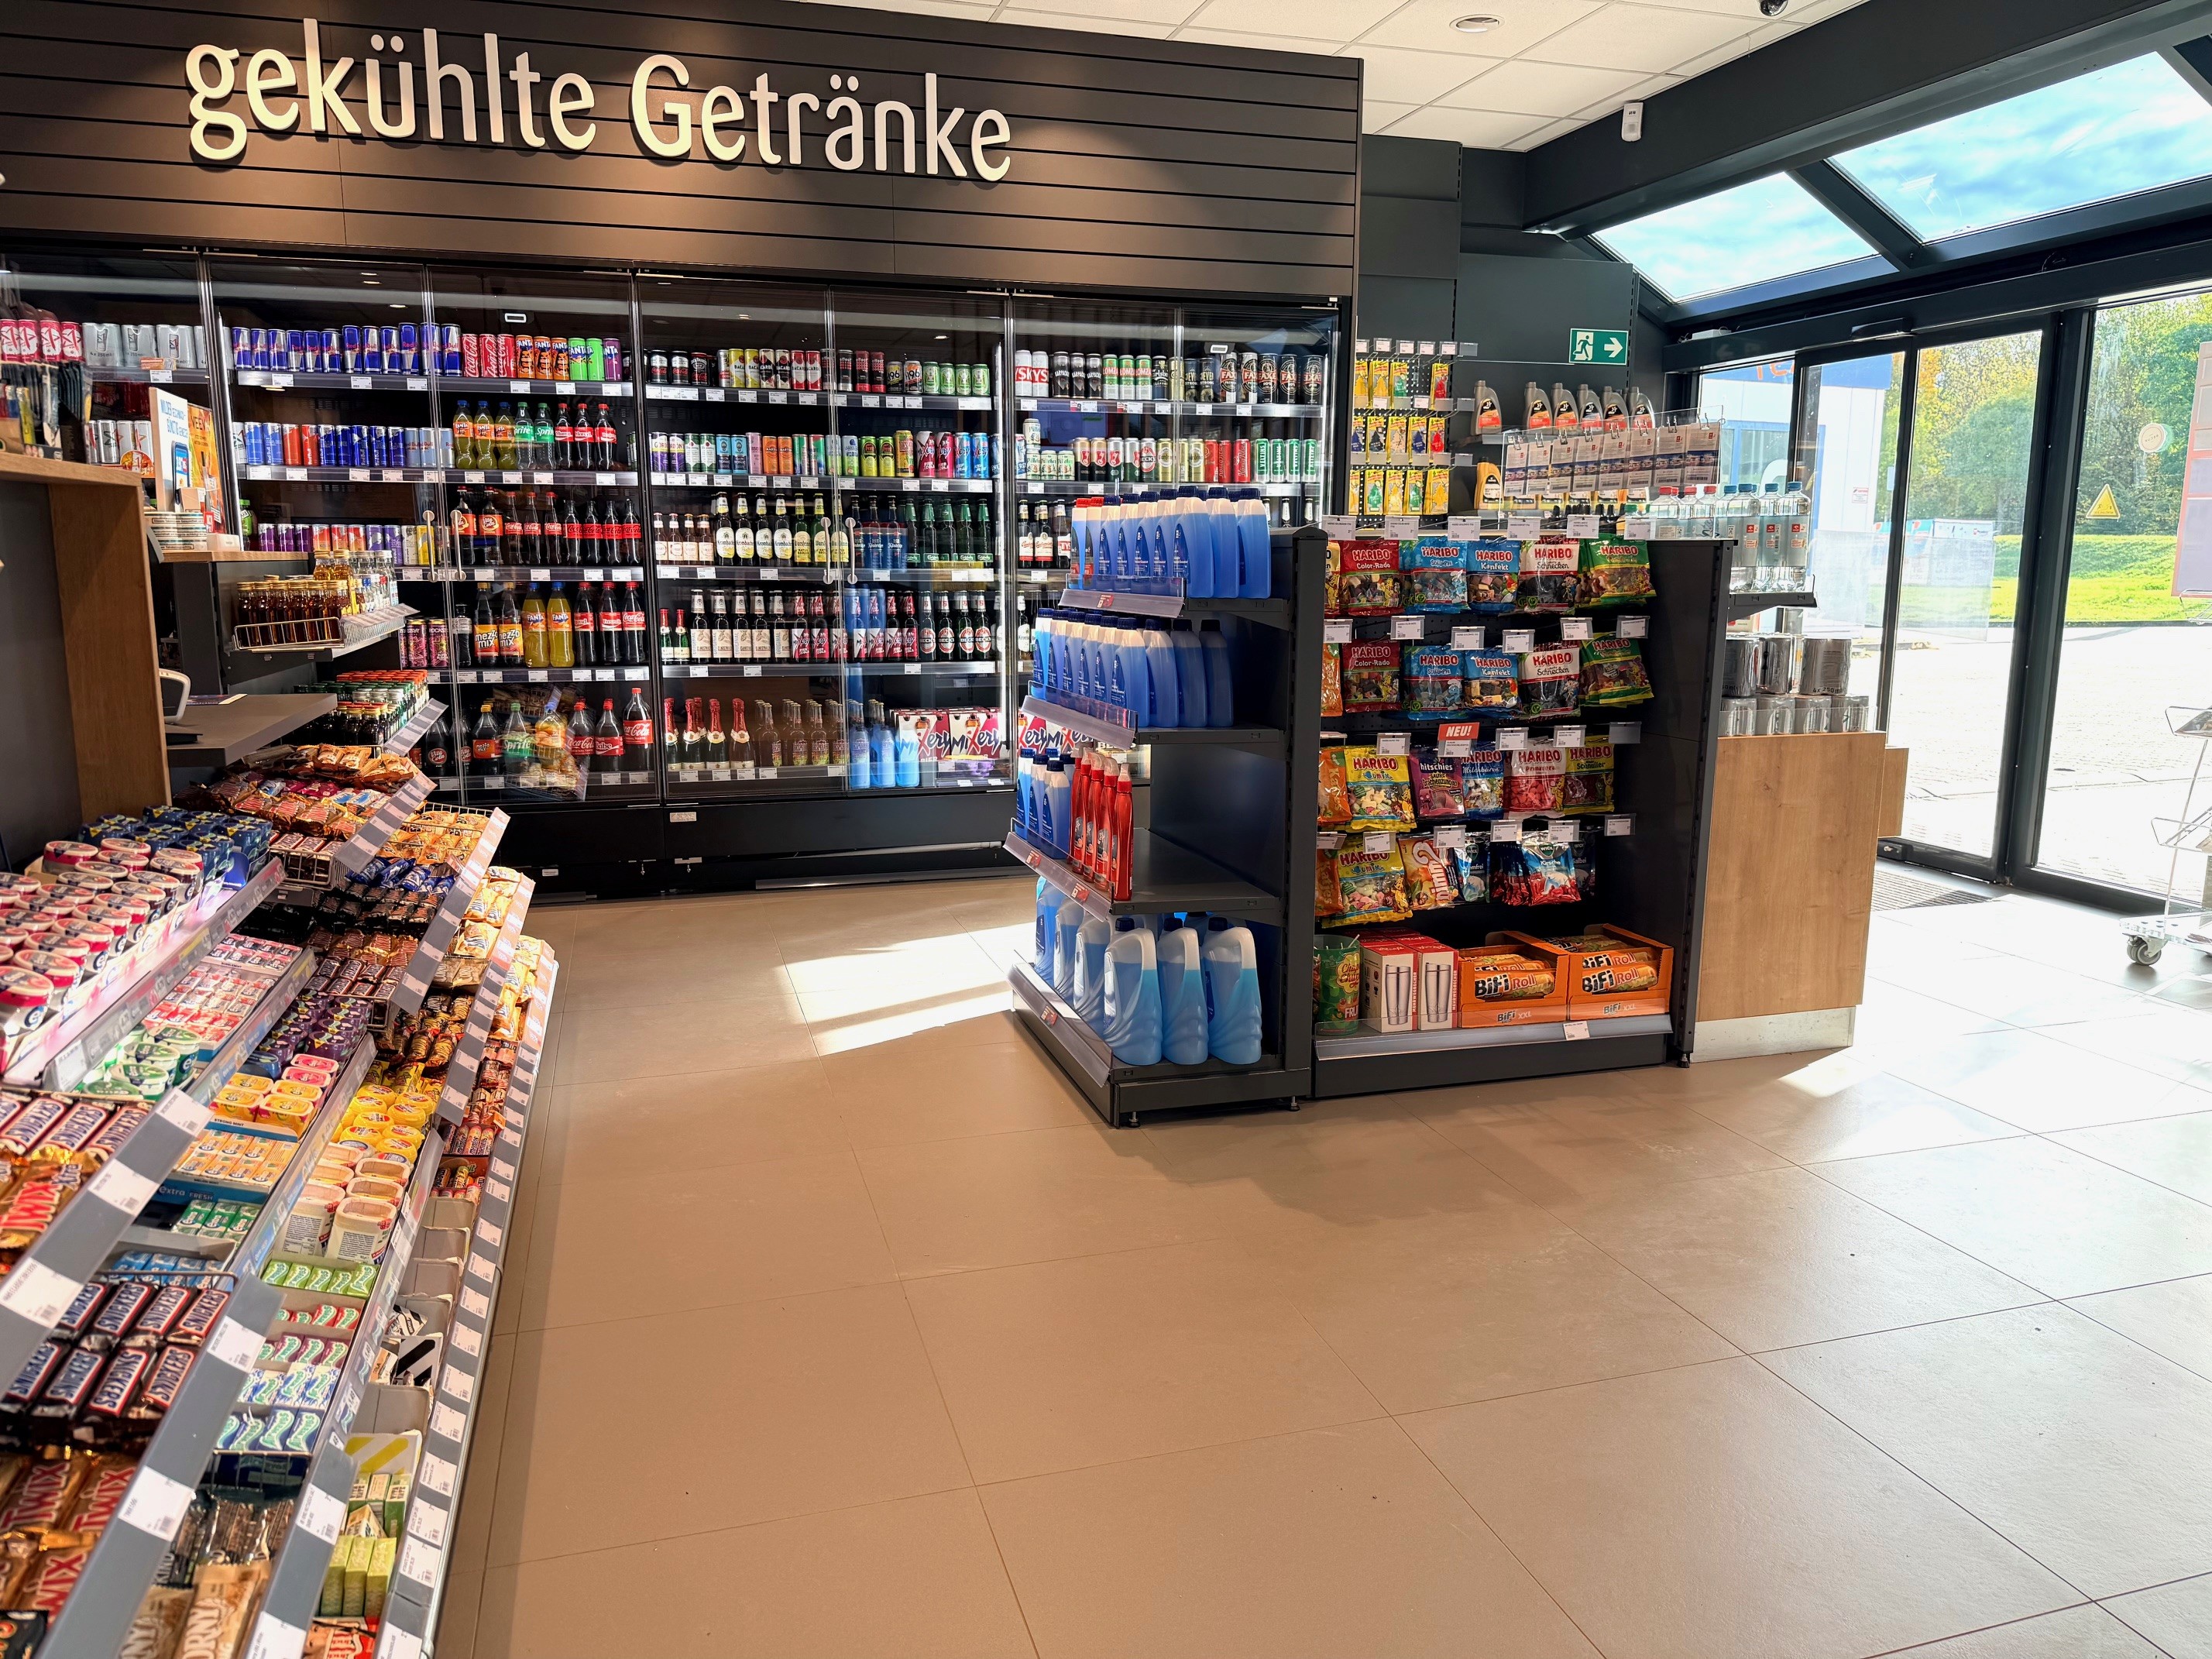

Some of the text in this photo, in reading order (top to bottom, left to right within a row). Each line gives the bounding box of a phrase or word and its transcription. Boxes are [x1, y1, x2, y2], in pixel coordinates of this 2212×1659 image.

[184, 18, 1012, 183] gekühlte Getränke
[1015, 366, 1032, 381] YSK
[1352, 548, 1392, 561] HARIBO
[1421, 547, 1461, 558] HARIBO
[1475, 550, 1512, 562] HARIBO
[1534, 548, 1573, 559] HARIBO
[1601, 545, 1638, 555] HARIBO
[1593, 638, 1630, 650] HARIBO
[1352, 647, 1391, 658] HARIBO
[1533, 652, 1572, 665] HARIBO
[1420, 655, 1458, 665] HARIBO
[1475, 658, 1511, 668] HARIBO
[623, 723, 650, 737] ca-Cola
[1446, 726, 1472, 737] NEU!
[1018, 724, 1046, 755] Xery
[1519, 750, 1561, 763] HARIBO
[1570, 746, 1613, 760] HARIBO
[1352, 757, 1397, 770] HARIBO
[1612, 952, 1636, 966] Roll
[1475, 973, 1537, 997] BiFi Roll
[1582, 967, 1639, 993] BiFi Roll
[1345, 1007, 1358, 1018] FRU
[1603, 1002, 1637, 1014] BiFi XXL
[1497, 1010, 1532, 1022] BiFi XXL
[189, 1192, 214, 1200] FRESH
[35, 1552, 88, 1625] WIX
[183, 1598, 228, 1659] ORNY
